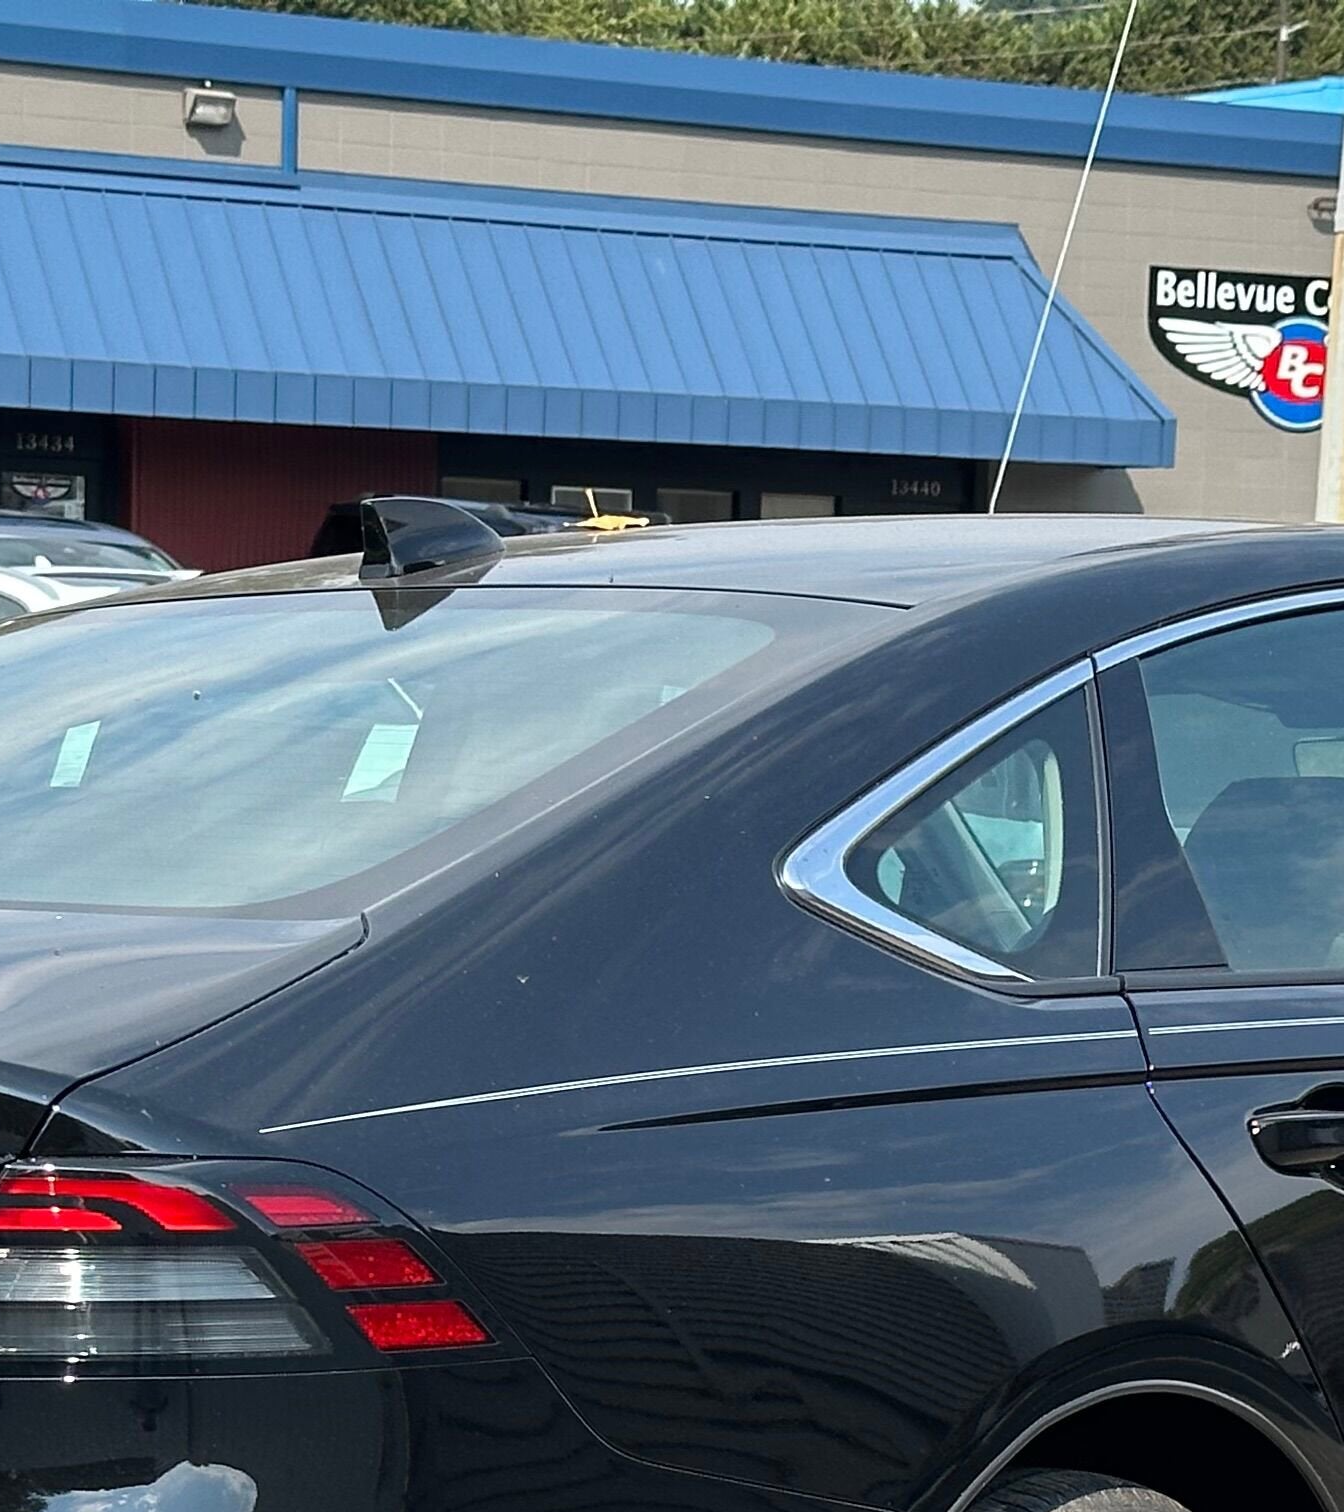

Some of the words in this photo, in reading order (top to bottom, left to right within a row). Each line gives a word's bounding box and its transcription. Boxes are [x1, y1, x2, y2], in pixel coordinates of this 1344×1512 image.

[1156, 269, 1296, 315] Bellevue
[15, 432, 75, 452] 13434
[890, 478, 942, 497] 13440
